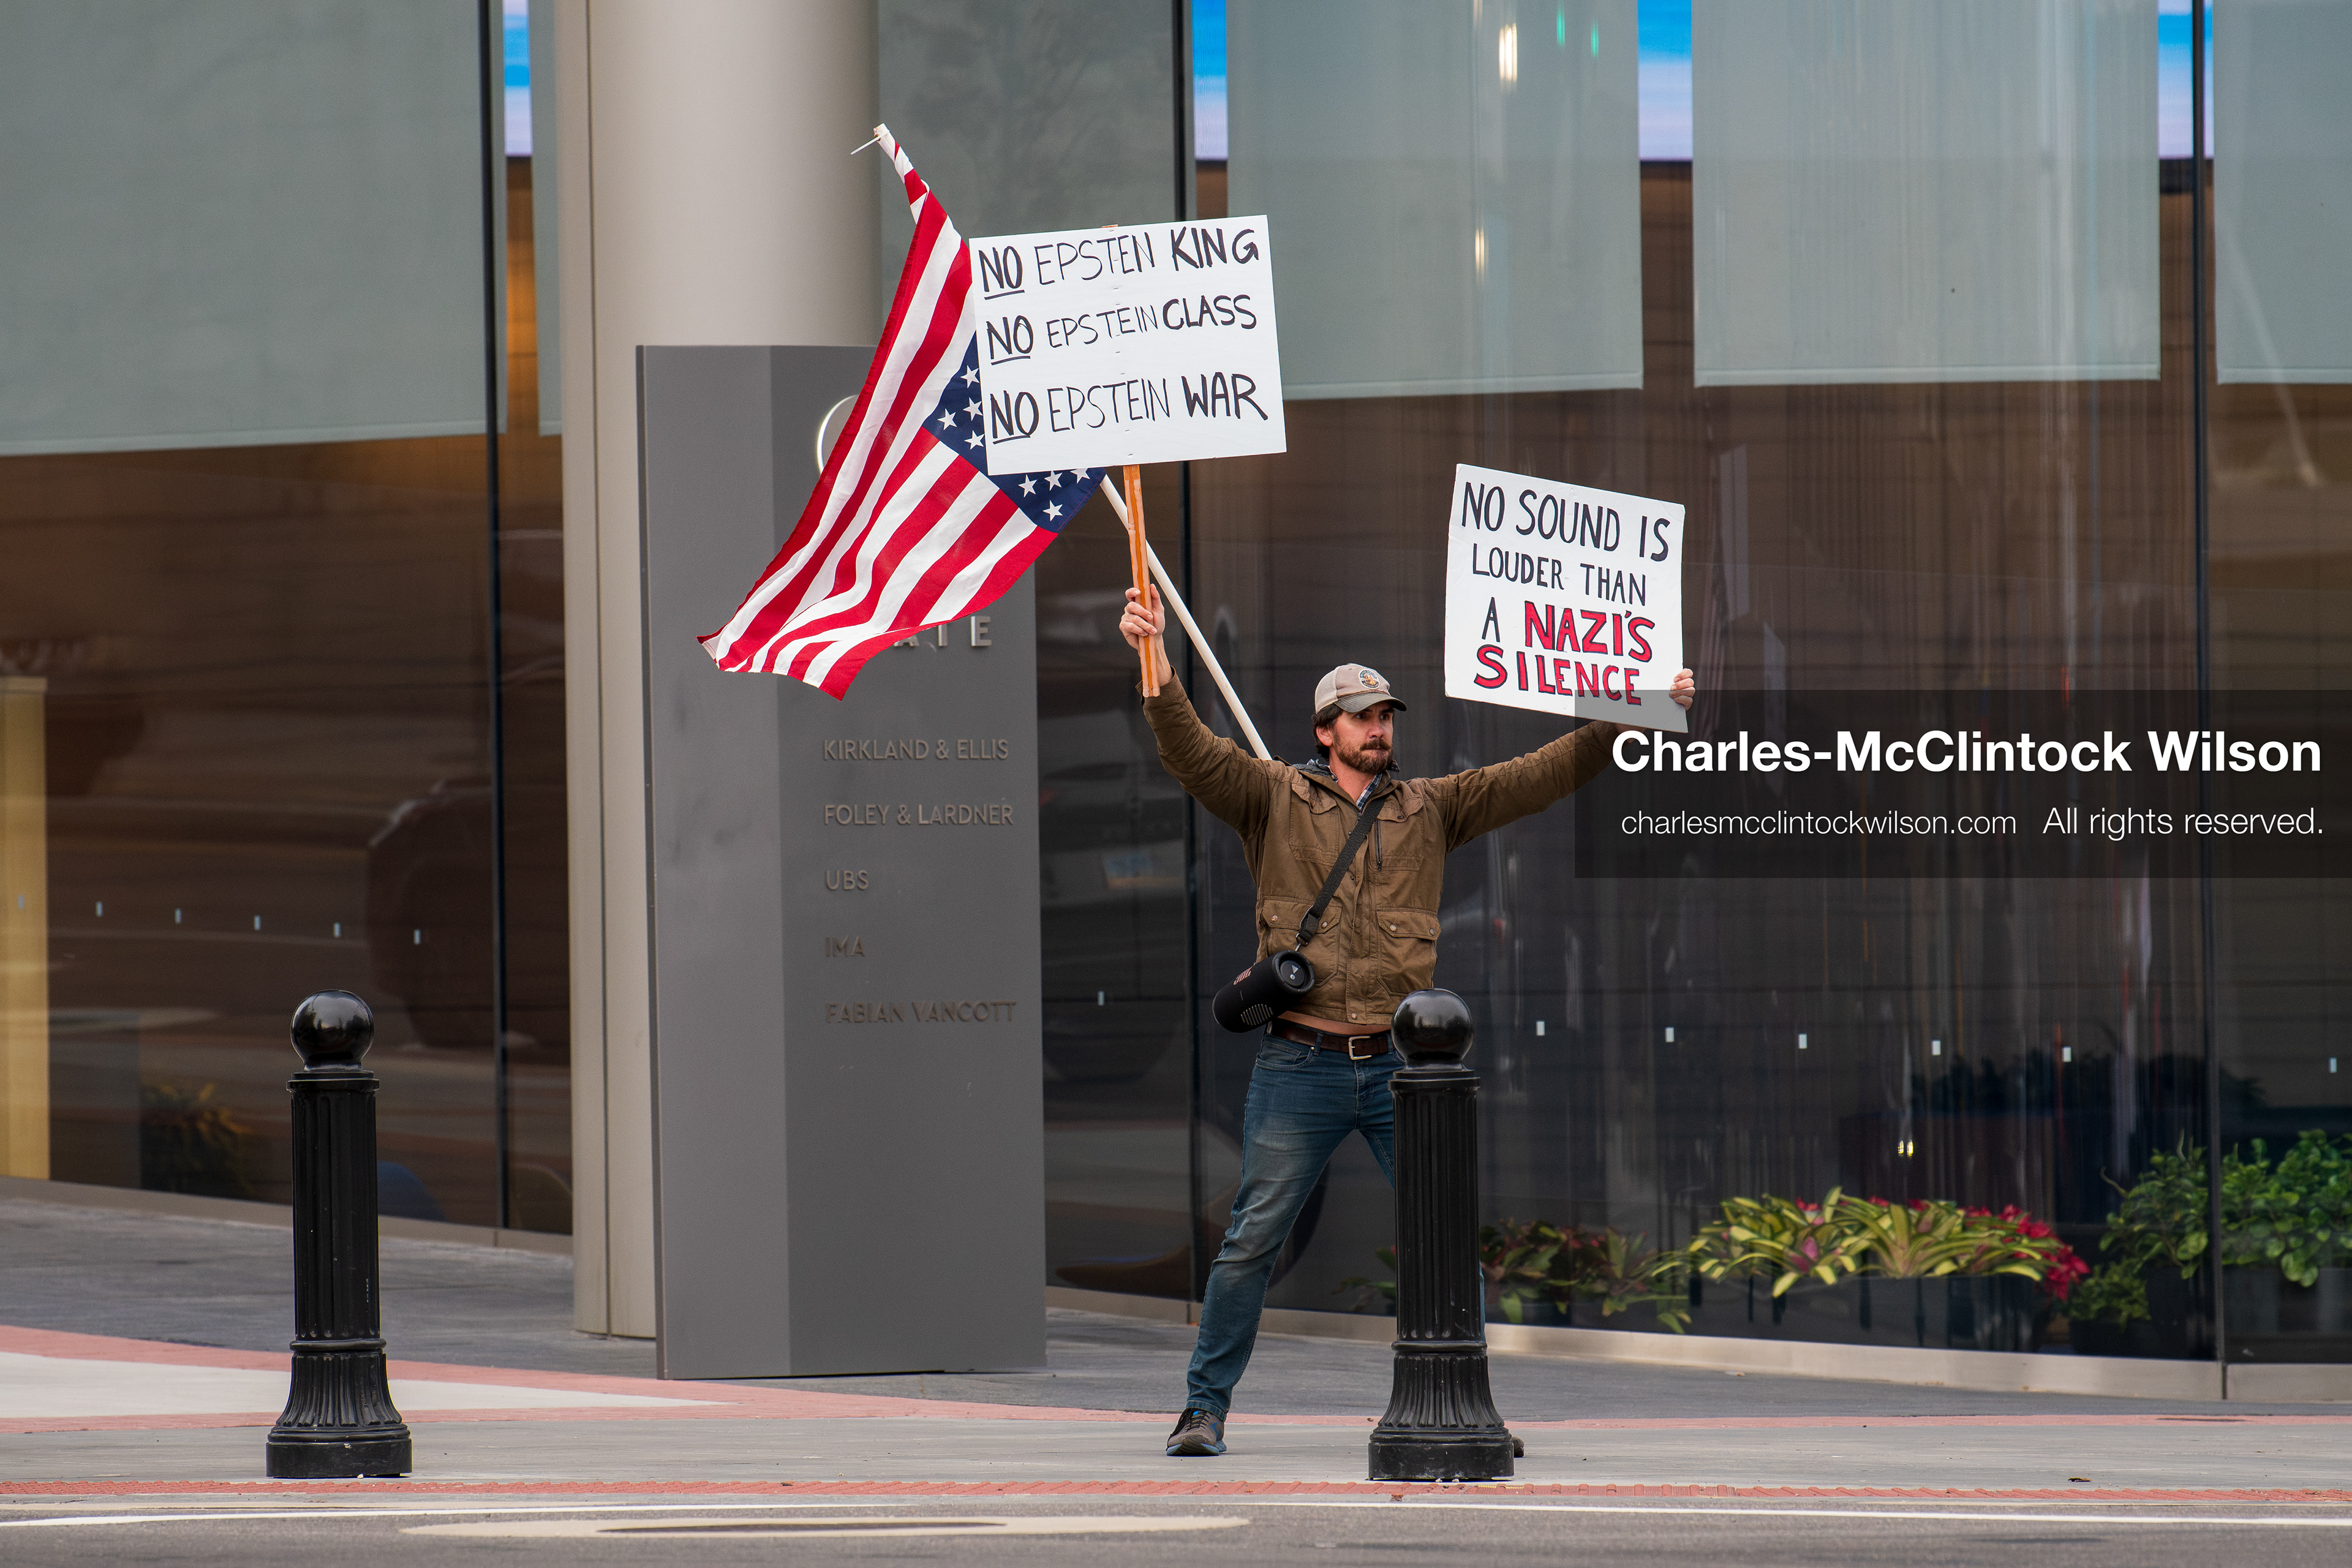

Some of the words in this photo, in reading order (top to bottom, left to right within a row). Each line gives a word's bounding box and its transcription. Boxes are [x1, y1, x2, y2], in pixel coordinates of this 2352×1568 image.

[978, 246, 1024, 292] NO
[1035, 232, 1155, 285] EPSTEN
[1170, 227, 1259, 271] KING
[986, 315, 1034, 360] NO
[1046, 304, 1158, 348] EPSTEIN
[1163, 295, 1257, 330] CLASS
[990, 390, 1039, 439] NO
[1048, 378, 1170, 432] EPSTEIN
[1182, 372, 1268, 420] WAR
[1461, 481, 1506, 532] NO
[1515, 489, 1621, 552] SOUND
[1639, 516, 1671, 562] IS
[1472, 543, 1565, 590] LOUDER
[1580, 563, 1646, 606] THAN
[1482, 597, 1501, 643] A
[1524, 600, 1655, 663] NAZI'S
[1474, 644, 1642, 706] SILENCE
[824, 739, 930, 760] KIRKLAND
[935, 739, 950, 760] &
[956, 738, 1009, 760] ELLIS
[824, 804, 889, 825] FOLEY
[896, 804, 912, 825] &
[918, 804, 1014, 825] LARDNER
[825, 870, 869, 890] UBS
[825, 935, 865, 958] IMA
[826, 1000, 906, 1023] FABIAN
[911, 1000, 1017, 1022] VANCOTT
